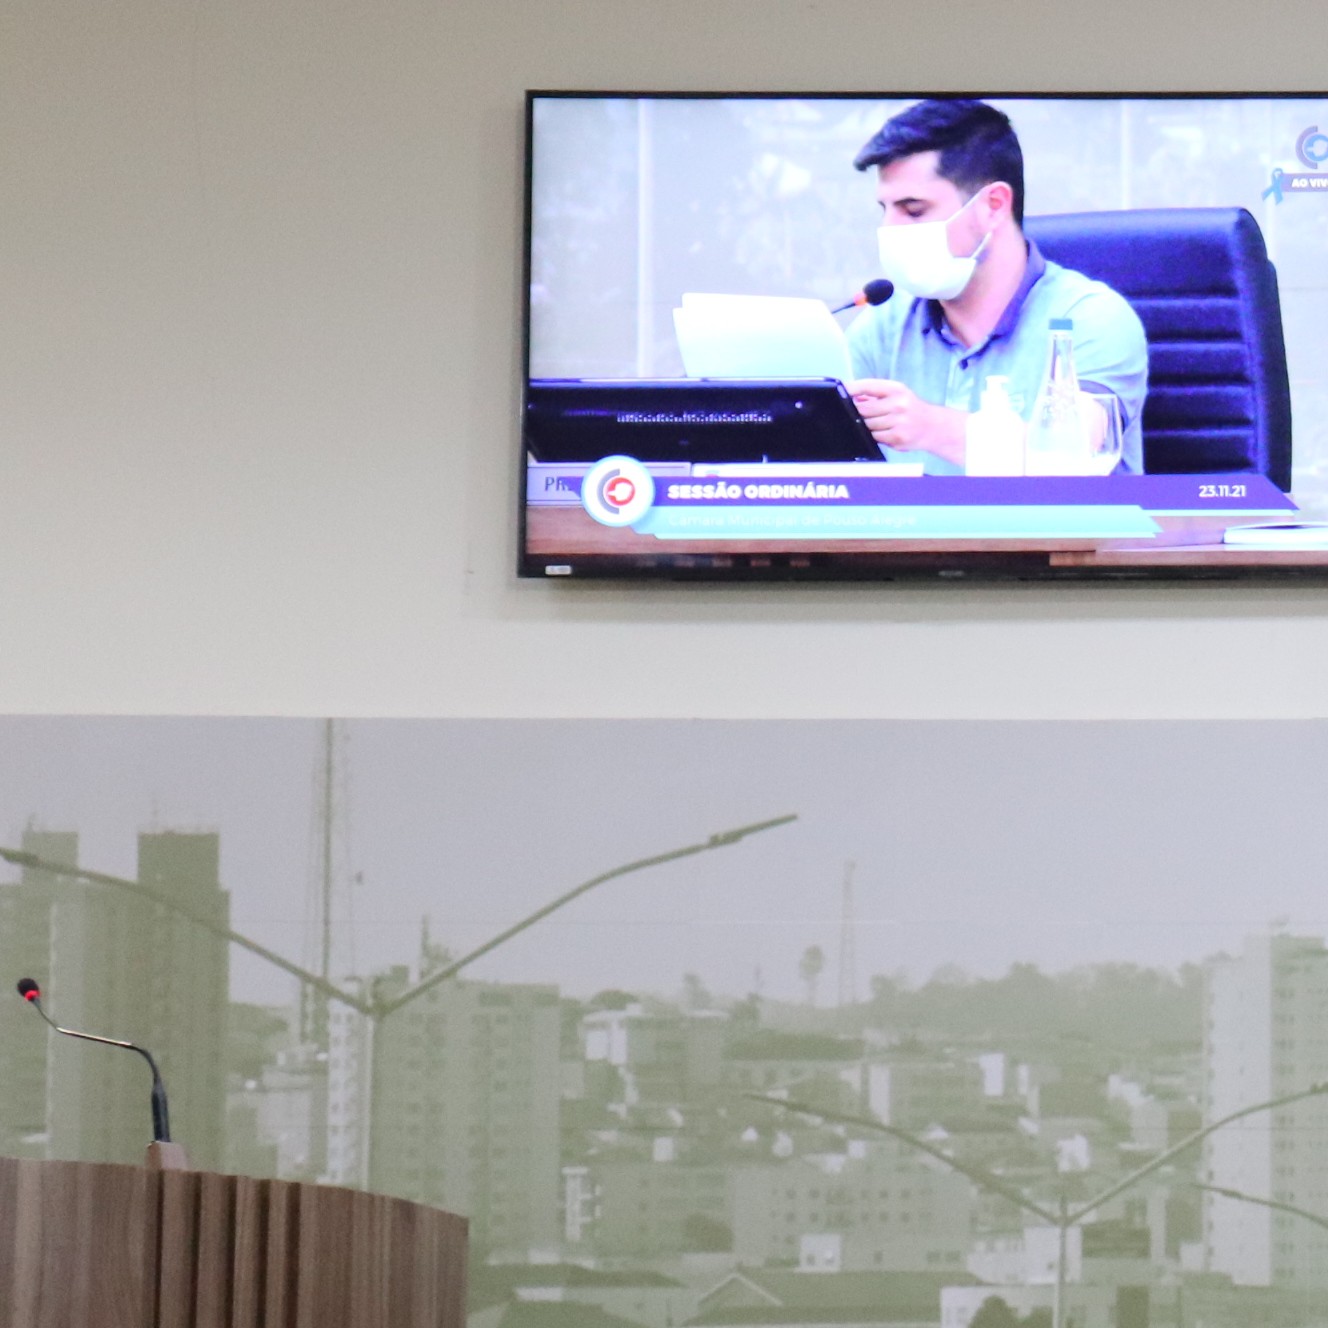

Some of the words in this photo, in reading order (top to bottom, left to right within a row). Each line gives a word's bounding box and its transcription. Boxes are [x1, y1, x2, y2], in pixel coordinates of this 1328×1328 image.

[1291, 178, 1308, 188] AO
[667, 481, 742, 499] SESSÃO
[743, 481, 850, 499] ORDINÁRIA
[1199, 485, 1246, 498] 23.11.21
